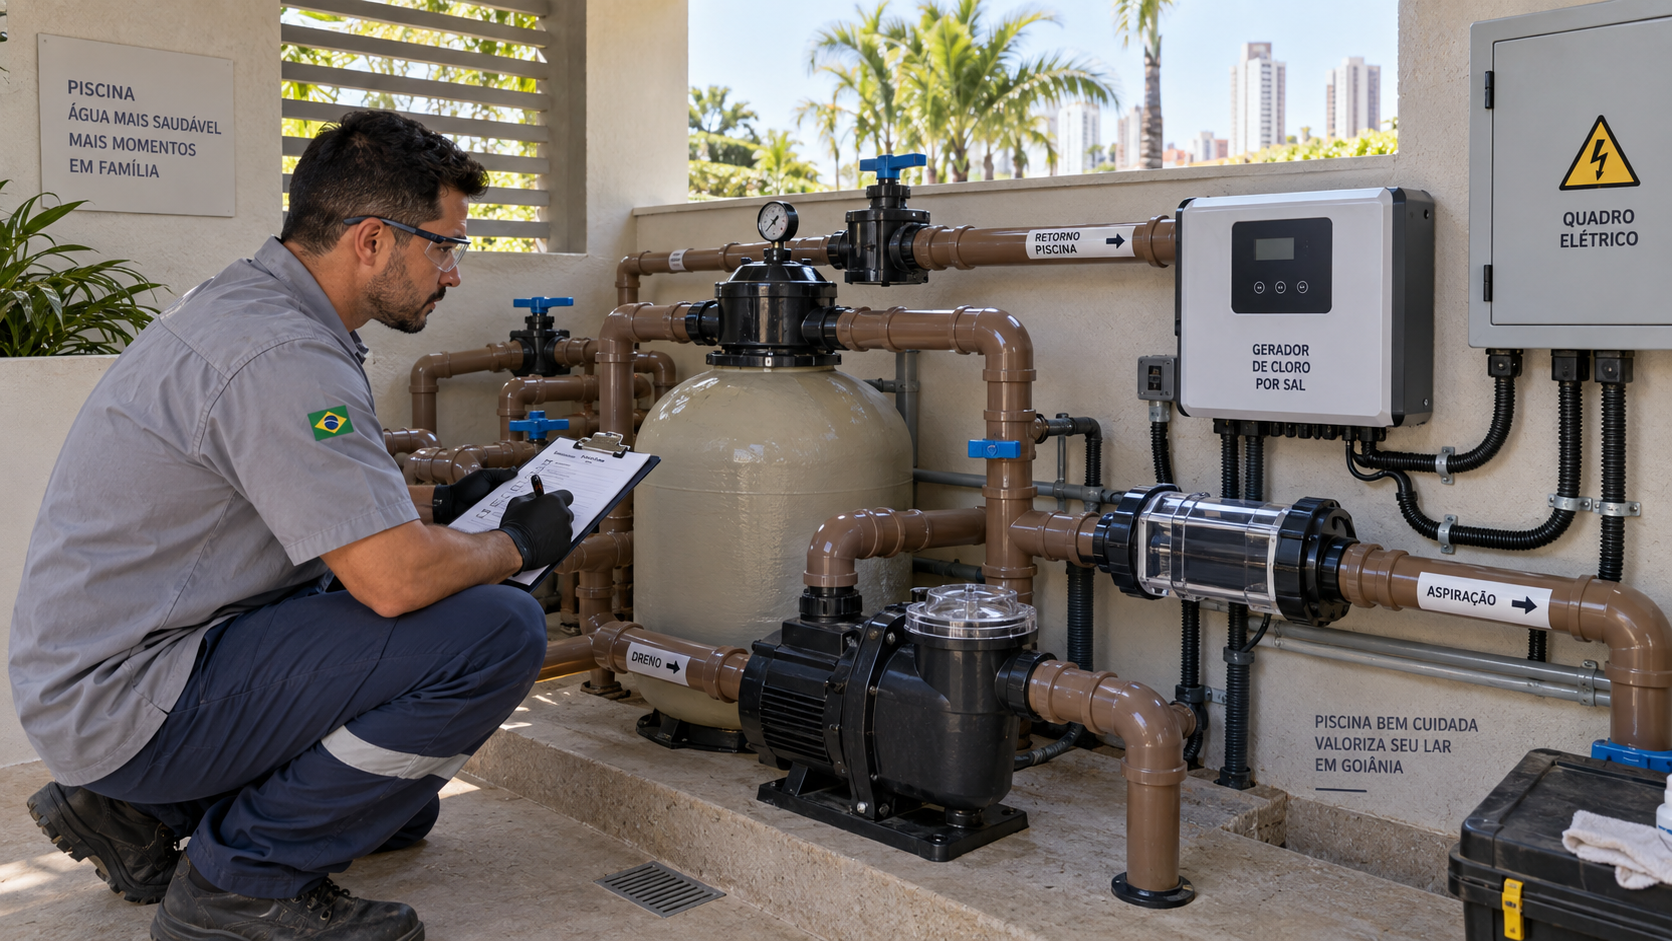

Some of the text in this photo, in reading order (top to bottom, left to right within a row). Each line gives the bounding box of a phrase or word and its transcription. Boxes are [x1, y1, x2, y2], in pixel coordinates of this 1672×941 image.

[67, 79, 135, 101] PISCINA
[68, 102, 222, 135] ÁGUA MAIS SAUDÁVEL
[69, 132, 197, 157] MAIS MOMENTOS
[69, 158, 160, 178] EM FAMÍLIA
[1562, 208, 1635, 228] QUADRO
[1035, 231, 1081, 242] RETORNO
[1560, 229, 1639, 248] ELÉTRICO
[1035, 244, 1077, 255] PISCINA
[1252, 343, 1310, 356] GERADOR
[1252, 360, 1311, 374] DE CLORO
[1256, 378, 1306, 391] POR SAL
[1427, 585, 1496, 606] ASPIRAÇÃO
[631, 651, 662, 669] DRENO
[1315, 714, 1479, 733] PISCINA BEM CUIDADA
[1315, 736, 1452, 754] VALORIZA SEU LAR
[1315, 756, 1404, 774] EM GOIÂNIA
